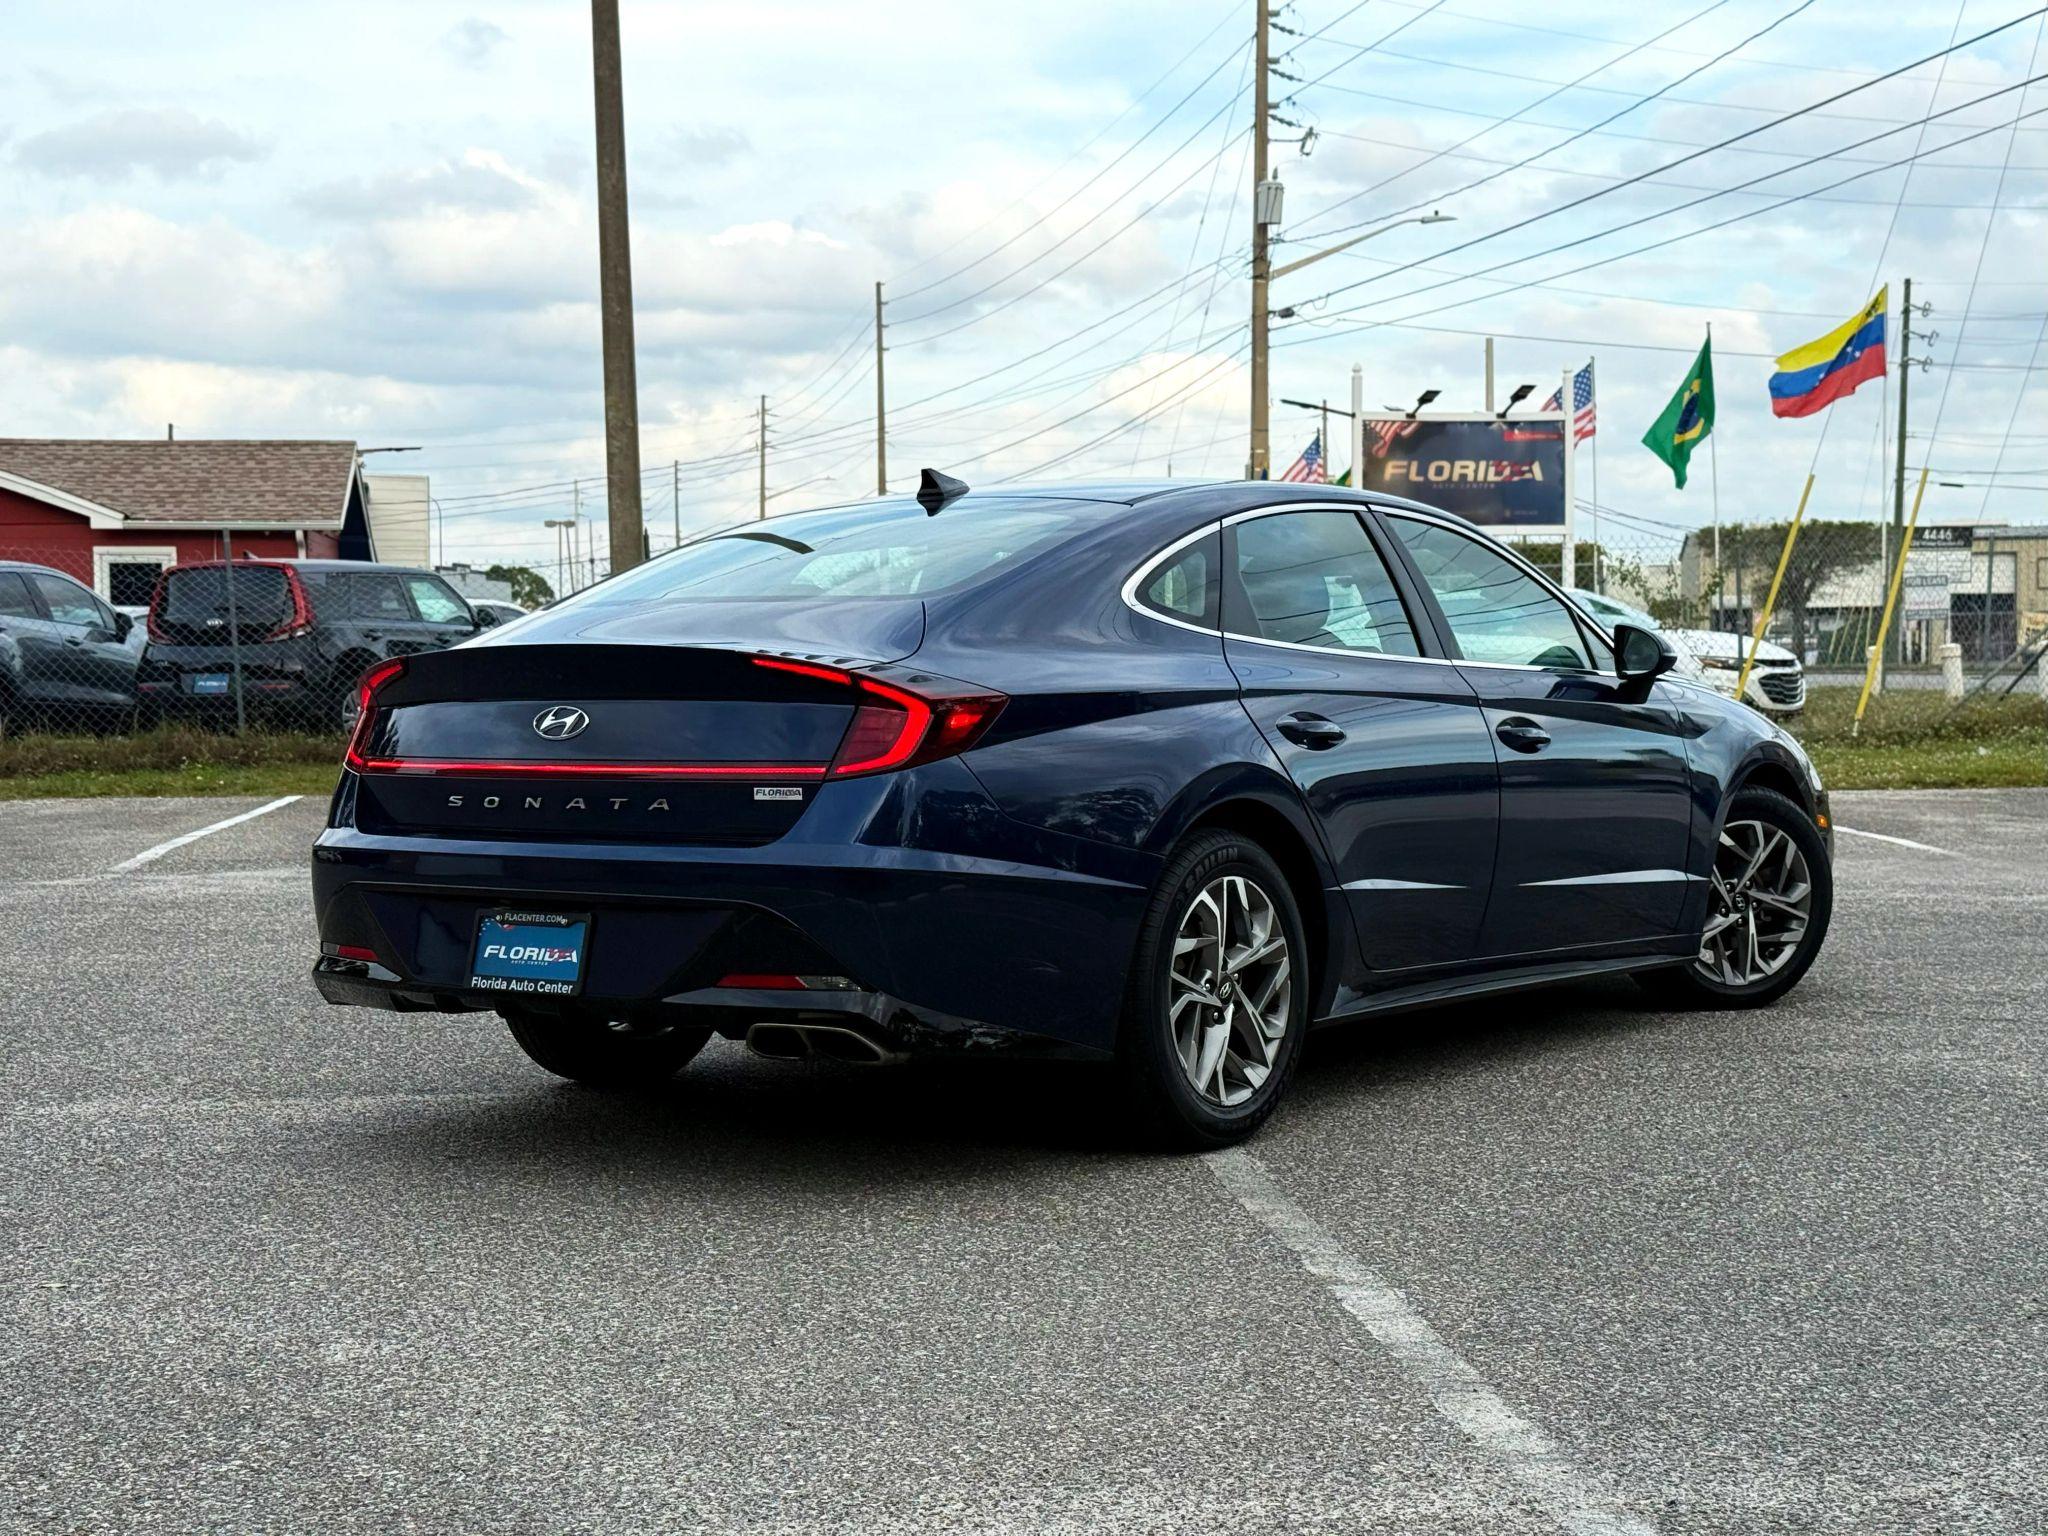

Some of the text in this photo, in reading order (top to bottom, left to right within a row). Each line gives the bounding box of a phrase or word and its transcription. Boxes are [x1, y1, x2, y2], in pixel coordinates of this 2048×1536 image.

[1383, 460, 1543, 482] FLORIDA
[1922, 528, 1952, 540] 4446
[448, 795, 670, 811] SONATA
[504, 913, 563, 923] FLACENTER.COM
[483, 945, 578, 963] FLORIDA
[471, 976, 573, 994] Florida Auto Center
